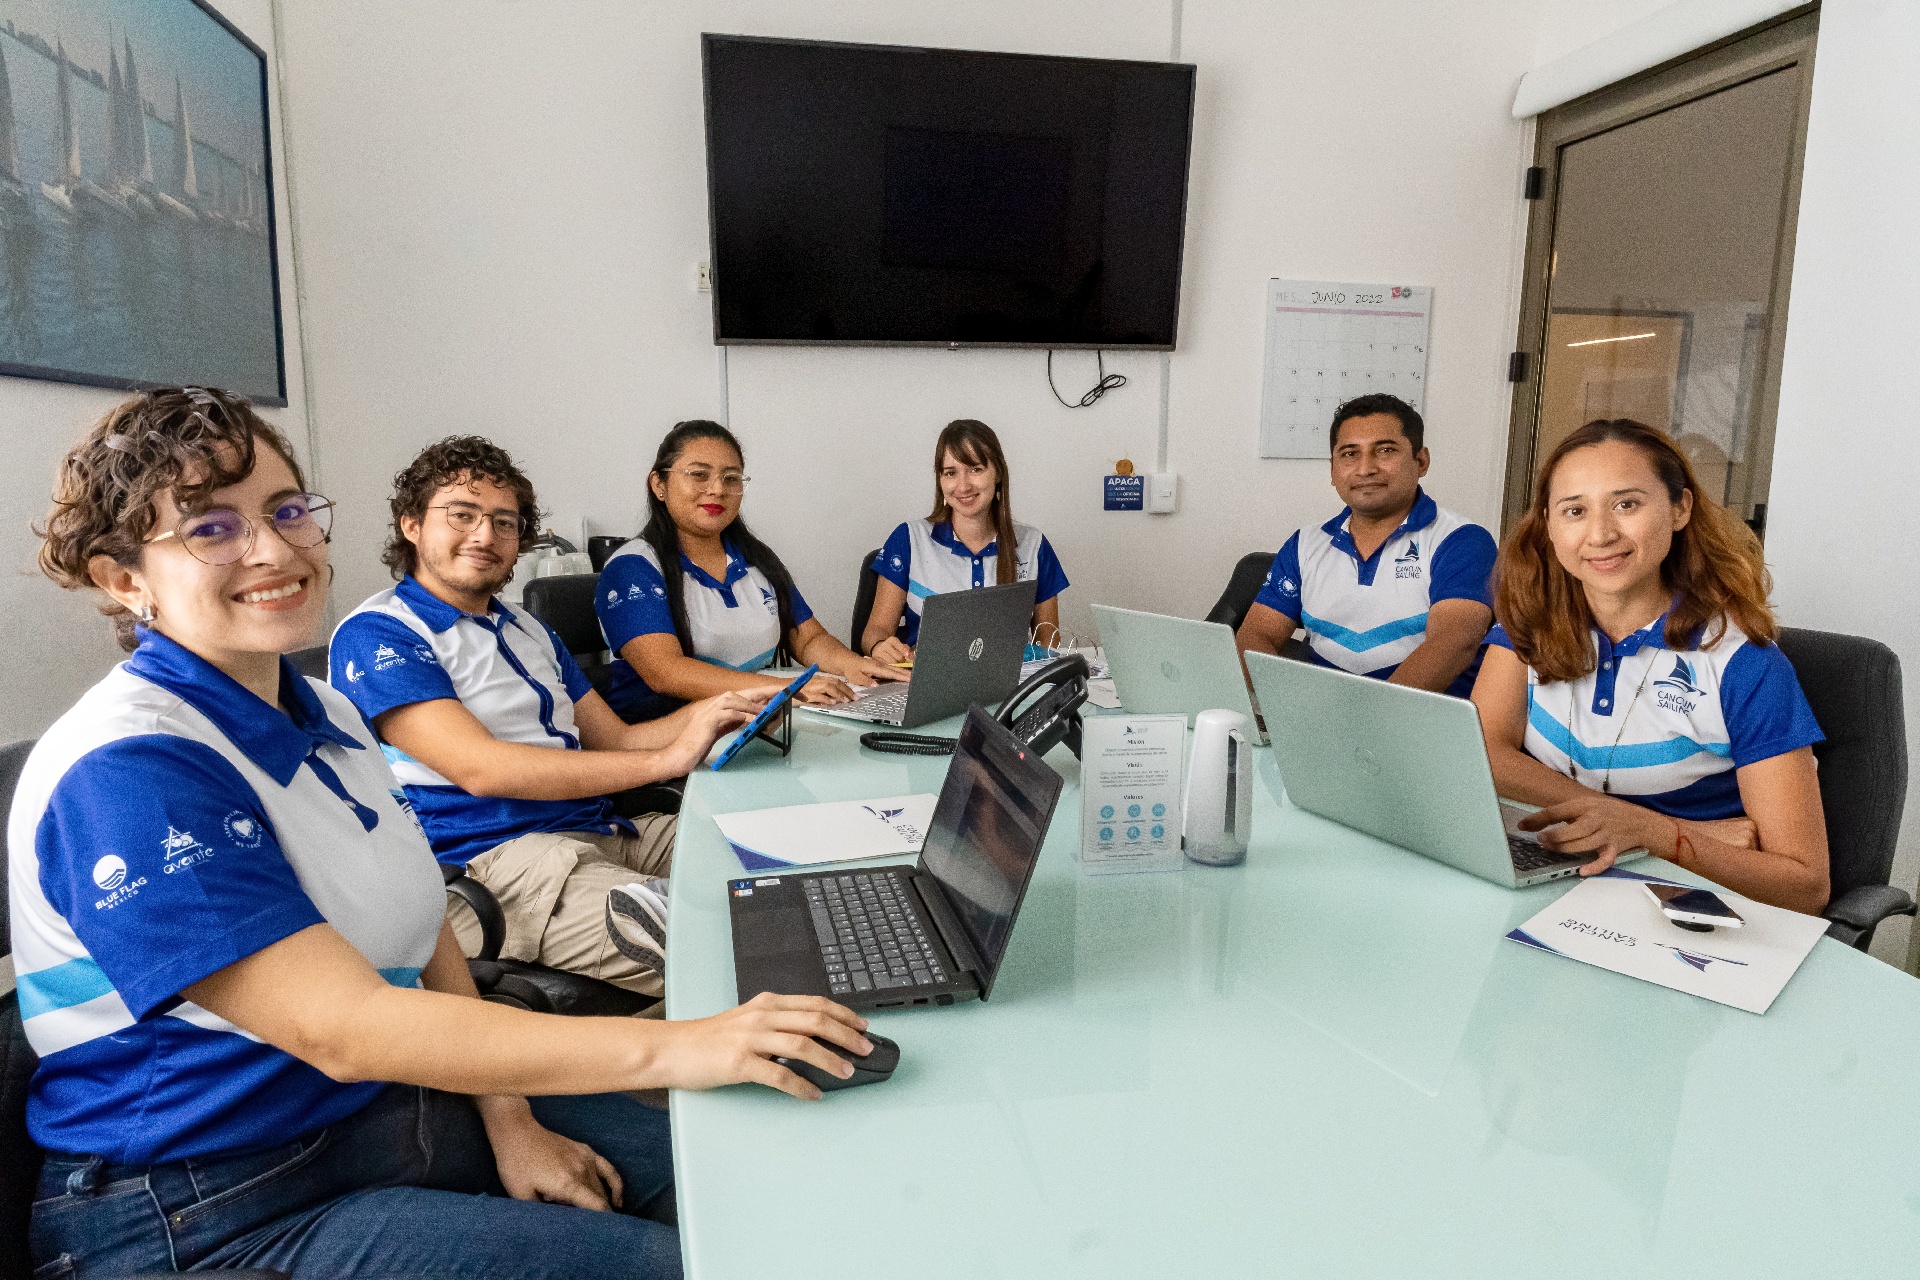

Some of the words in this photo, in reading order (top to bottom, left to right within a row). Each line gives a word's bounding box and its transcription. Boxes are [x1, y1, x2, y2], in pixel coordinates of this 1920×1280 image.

[1311, 291, 1346, 304] JUNIO
[1355, 294, 1384, 304] 2022
[1107, 477, 1141, 486] APAGA
[163, 847, 214, 874] avante
[95, 891, 119, 910] BLUE
[118, 876, 147, 897] FLAG
[107, 890, 139, 910] MEXICO
